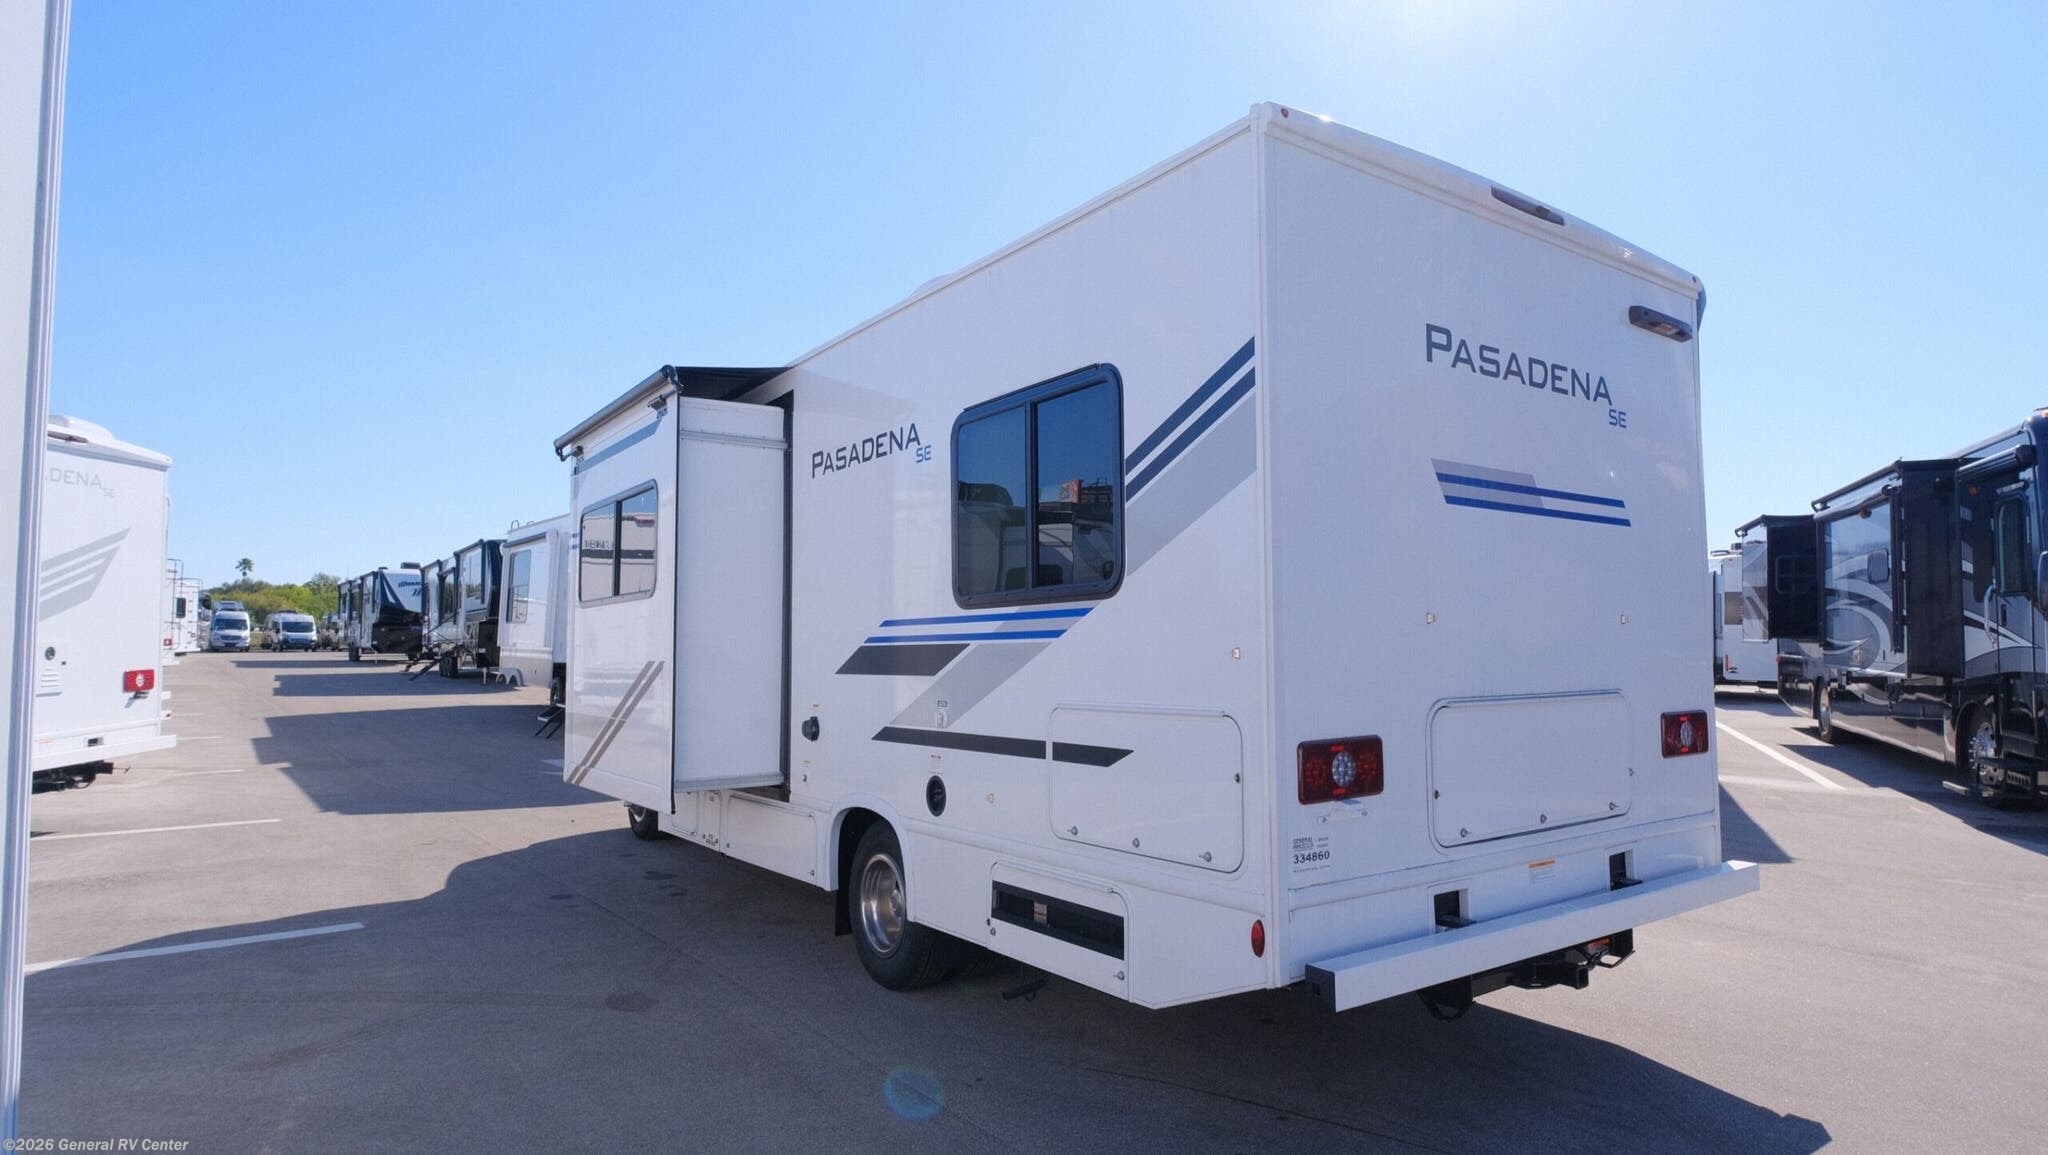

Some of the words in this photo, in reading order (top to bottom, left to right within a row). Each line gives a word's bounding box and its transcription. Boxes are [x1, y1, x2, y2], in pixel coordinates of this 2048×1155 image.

[1426, 323, 1613, 406] PASADENA
[1608, 408, 1628, 429] SE
[811, 423, 921, 479] PASADENA
[915, 444, 932, 463] SE
[45, 467, 102, 488] DENA
[1293, 850, 1330, 864] 334860
